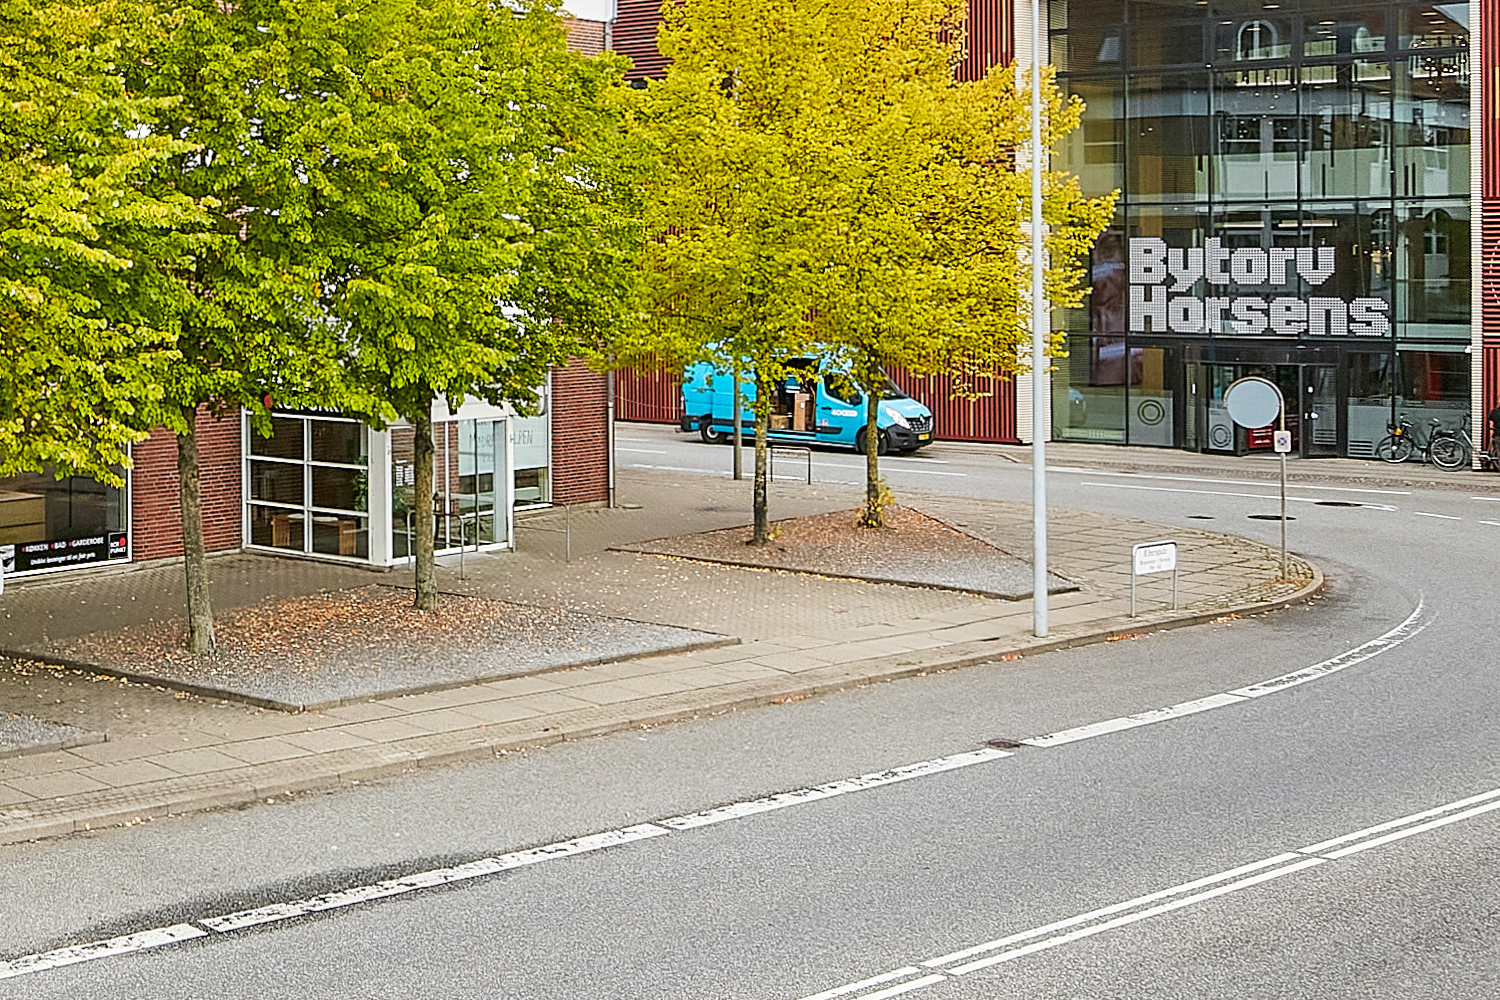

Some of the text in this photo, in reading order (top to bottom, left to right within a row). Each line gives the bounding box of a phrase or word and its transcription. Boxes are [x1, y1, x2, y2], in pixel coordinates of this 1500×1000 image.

[1129, 237, 1335, 292] Bytorv
[1129, 285, 1389, 336] Horsens
[54, 541, 67, 549] BAD
